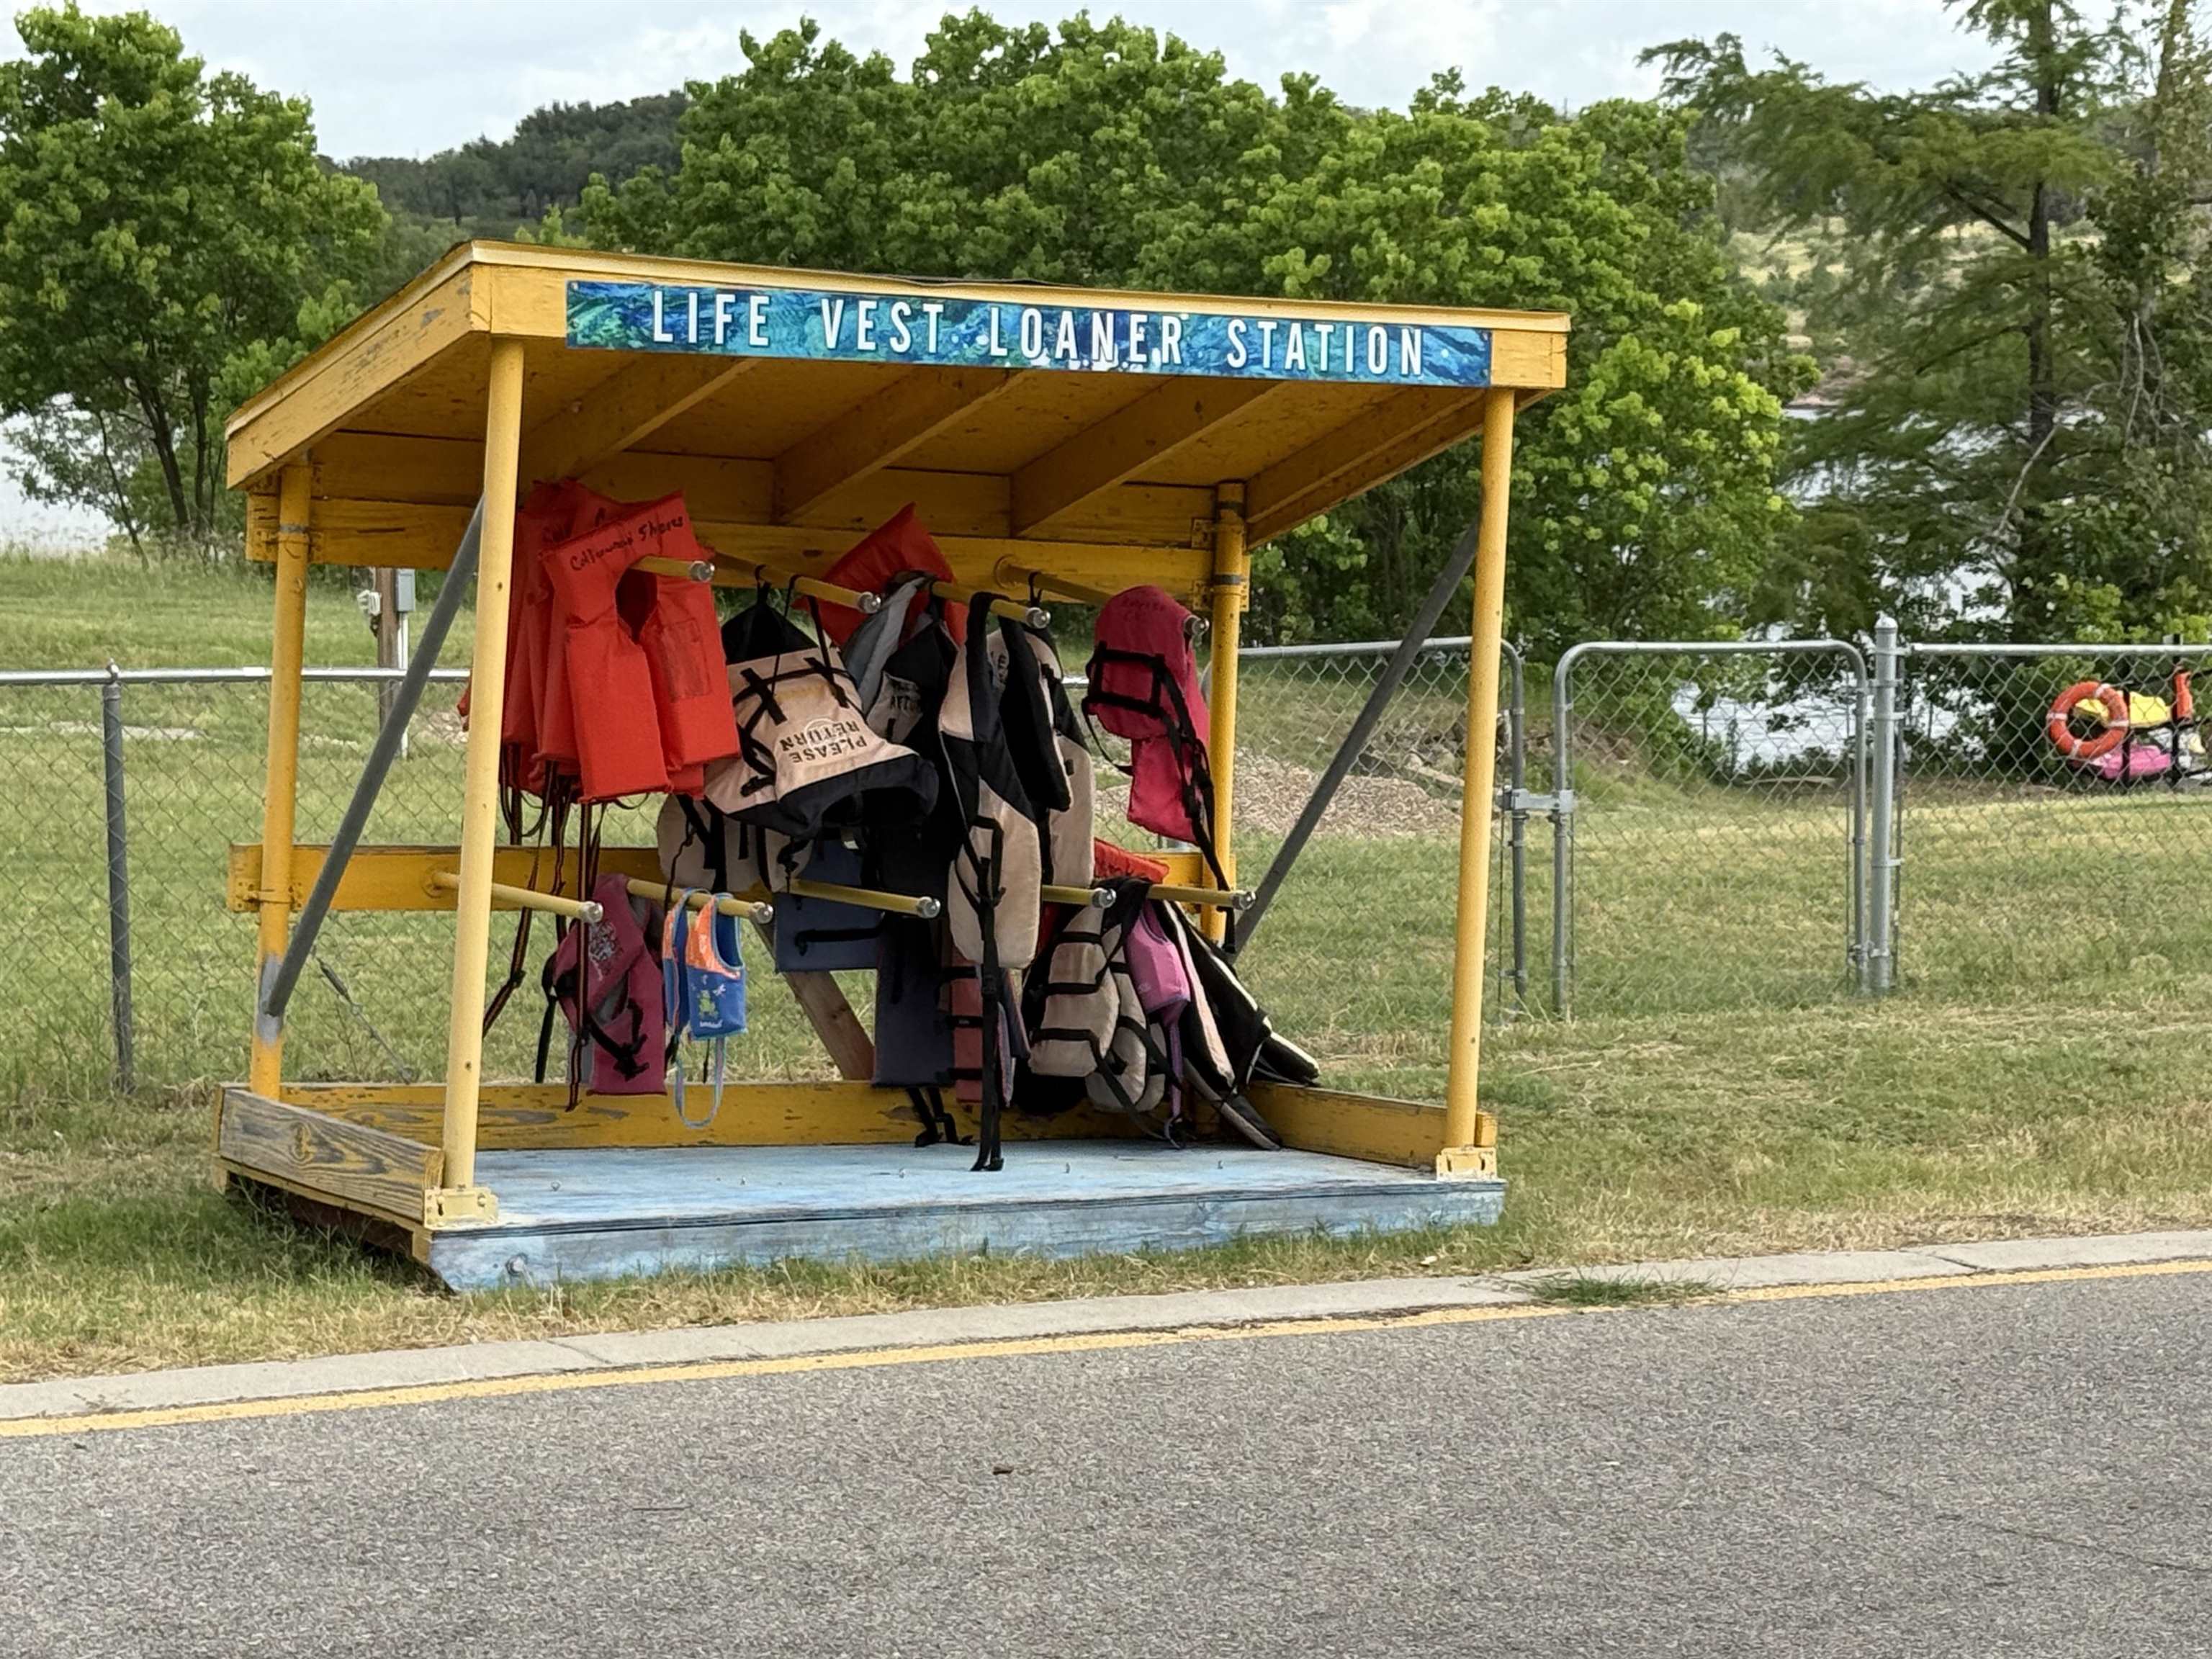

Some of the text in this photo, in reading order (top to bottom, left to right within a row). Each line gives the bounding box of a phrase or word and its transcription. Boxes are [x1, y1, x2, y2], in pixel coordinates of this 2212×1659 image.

[653, 290, 1423, 377] LIFE VEST LOANER STATION
[780, 721, 860, 752] RETURN
[788, 735, 868, 763] PLEASE
